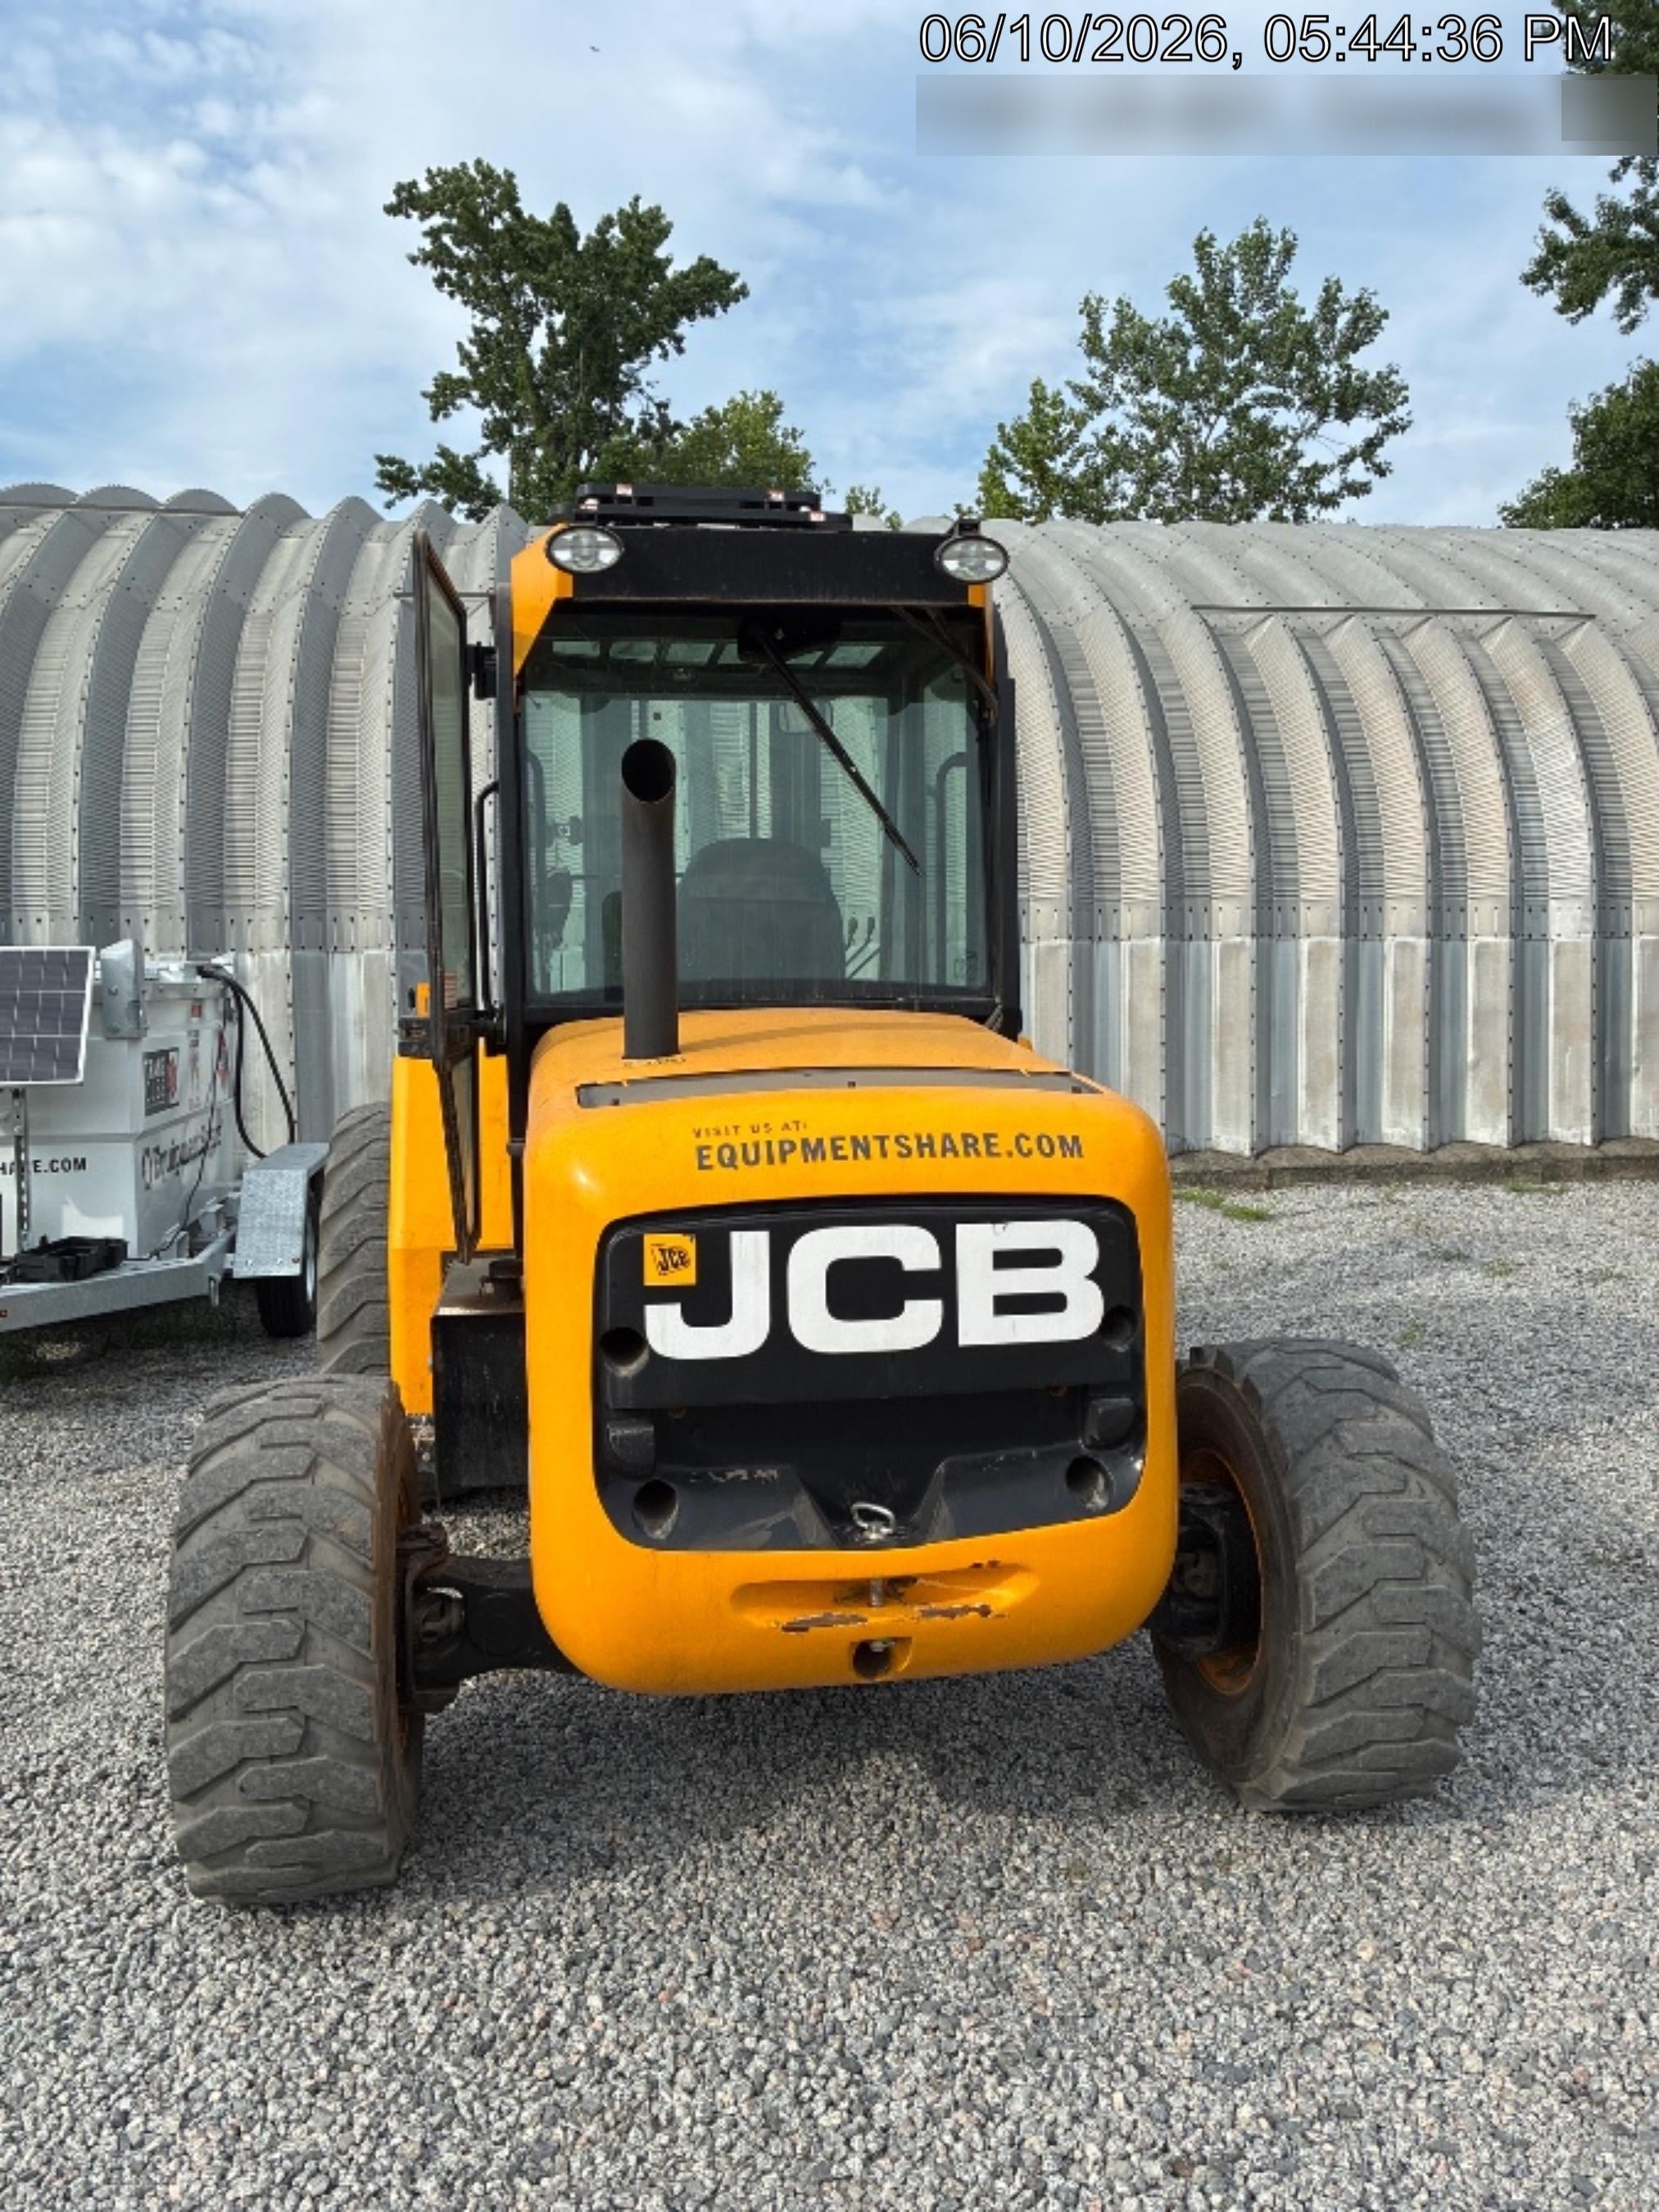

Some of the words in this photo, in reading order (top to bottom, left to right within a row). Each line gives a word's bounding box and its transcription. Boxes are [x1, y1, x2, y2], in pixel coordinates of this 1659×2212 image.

[692, 1125, 741, 1138] VISIT
[751, 1122, 773, 1134] US
[696, 1132, 1085, 1171] EQUIPMENTSHARE.COM
[657, 1246, 690, 1272] JCB
[644, 1219, 1105, 1360] JCB
